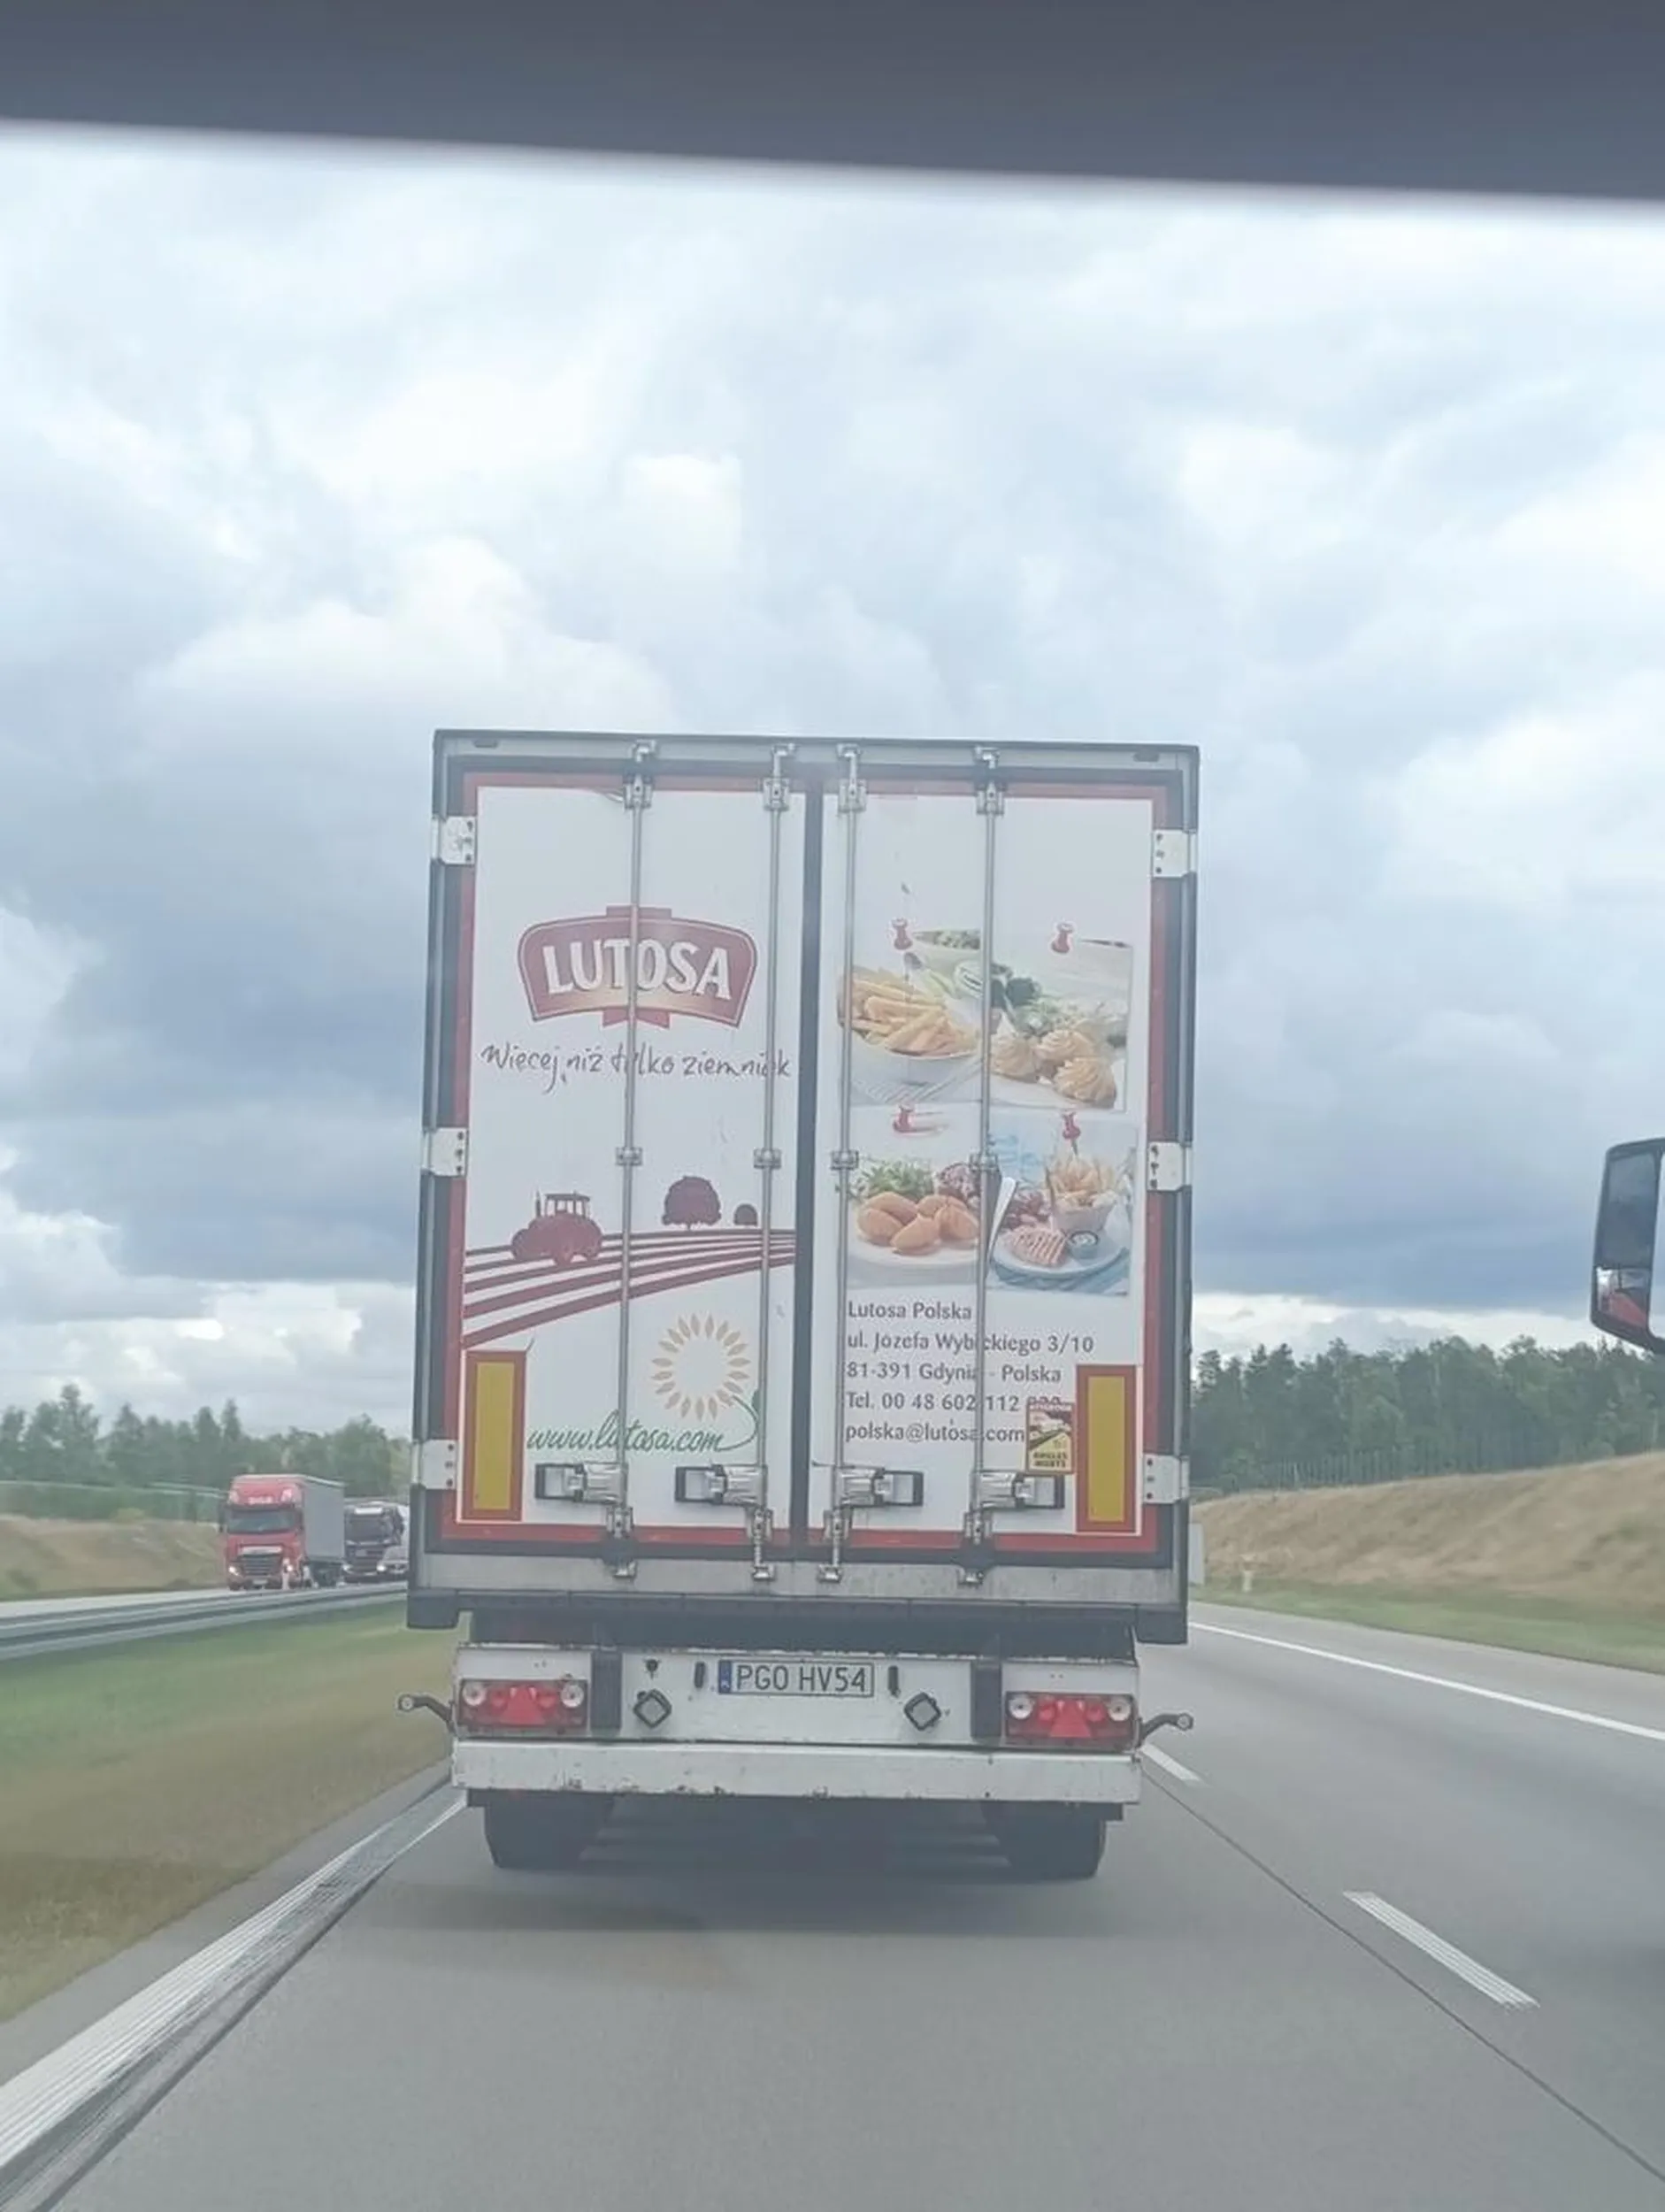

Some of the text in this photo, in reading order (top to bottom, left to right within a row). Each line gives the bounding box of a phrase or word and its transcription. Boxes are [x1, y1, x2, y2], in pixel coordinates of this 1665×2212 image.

[541, 938, 732, 1001] LUTOSA
[848, 1301, 972, 1320] Lutosa Polska
[848, 1330, 868, 1348] ul.
[934, 1332, 1041, 1356] Wybckiego
[1047, 1333, 1094, 1354] 3/10
[847, 1362, 910, 1379] 81-391
[1001, 1364, 1062, 1383] Polska
[846, 1392, 875, 1409] Tel.
[881, 1393, 904, 1409] 00
[911, 1393, 934, 1410] 48
[941, 1394, 977, 1411] 602
[986, 1395, 1019, 1412] 112
[526, 1409, 725, 1452] www.lutosa.com
[736, 1664, 866, 1692] PGO HV54
